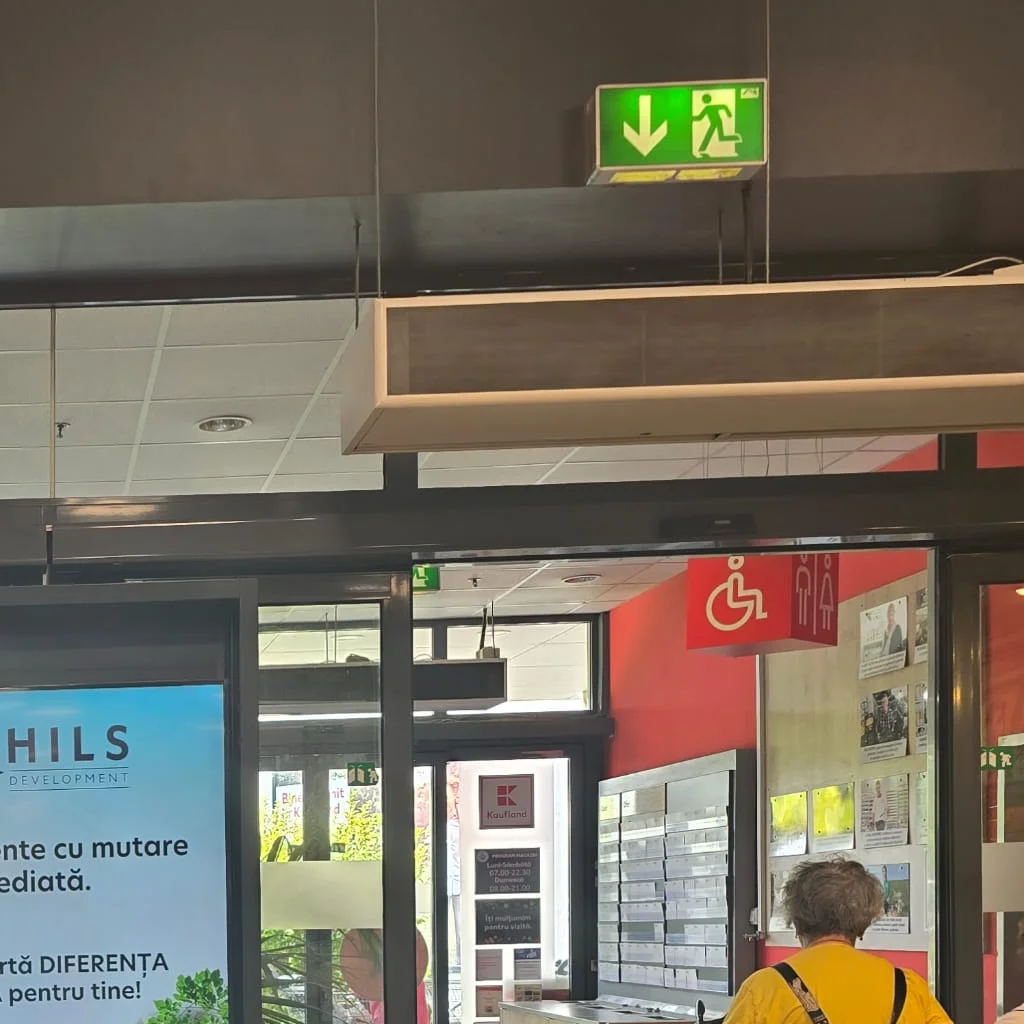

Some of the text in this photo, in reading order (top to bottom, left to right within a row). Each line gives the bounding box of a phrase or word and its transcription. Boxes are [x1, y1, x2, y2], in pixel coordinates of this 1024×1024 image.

[7, 724, 130, 764] HILS
[9, 771, 130, 786] DEVELOPMENT
[487, 809, 527, 820] Kaufland
[53, 844, 84, 859] cu
[91, 837, 189, 858] mutare
[40, 952, 169, 981] DIFERENȚA
[9, 983, 84, 1007] pentru
[90, 981, 142, 1000] tine!
